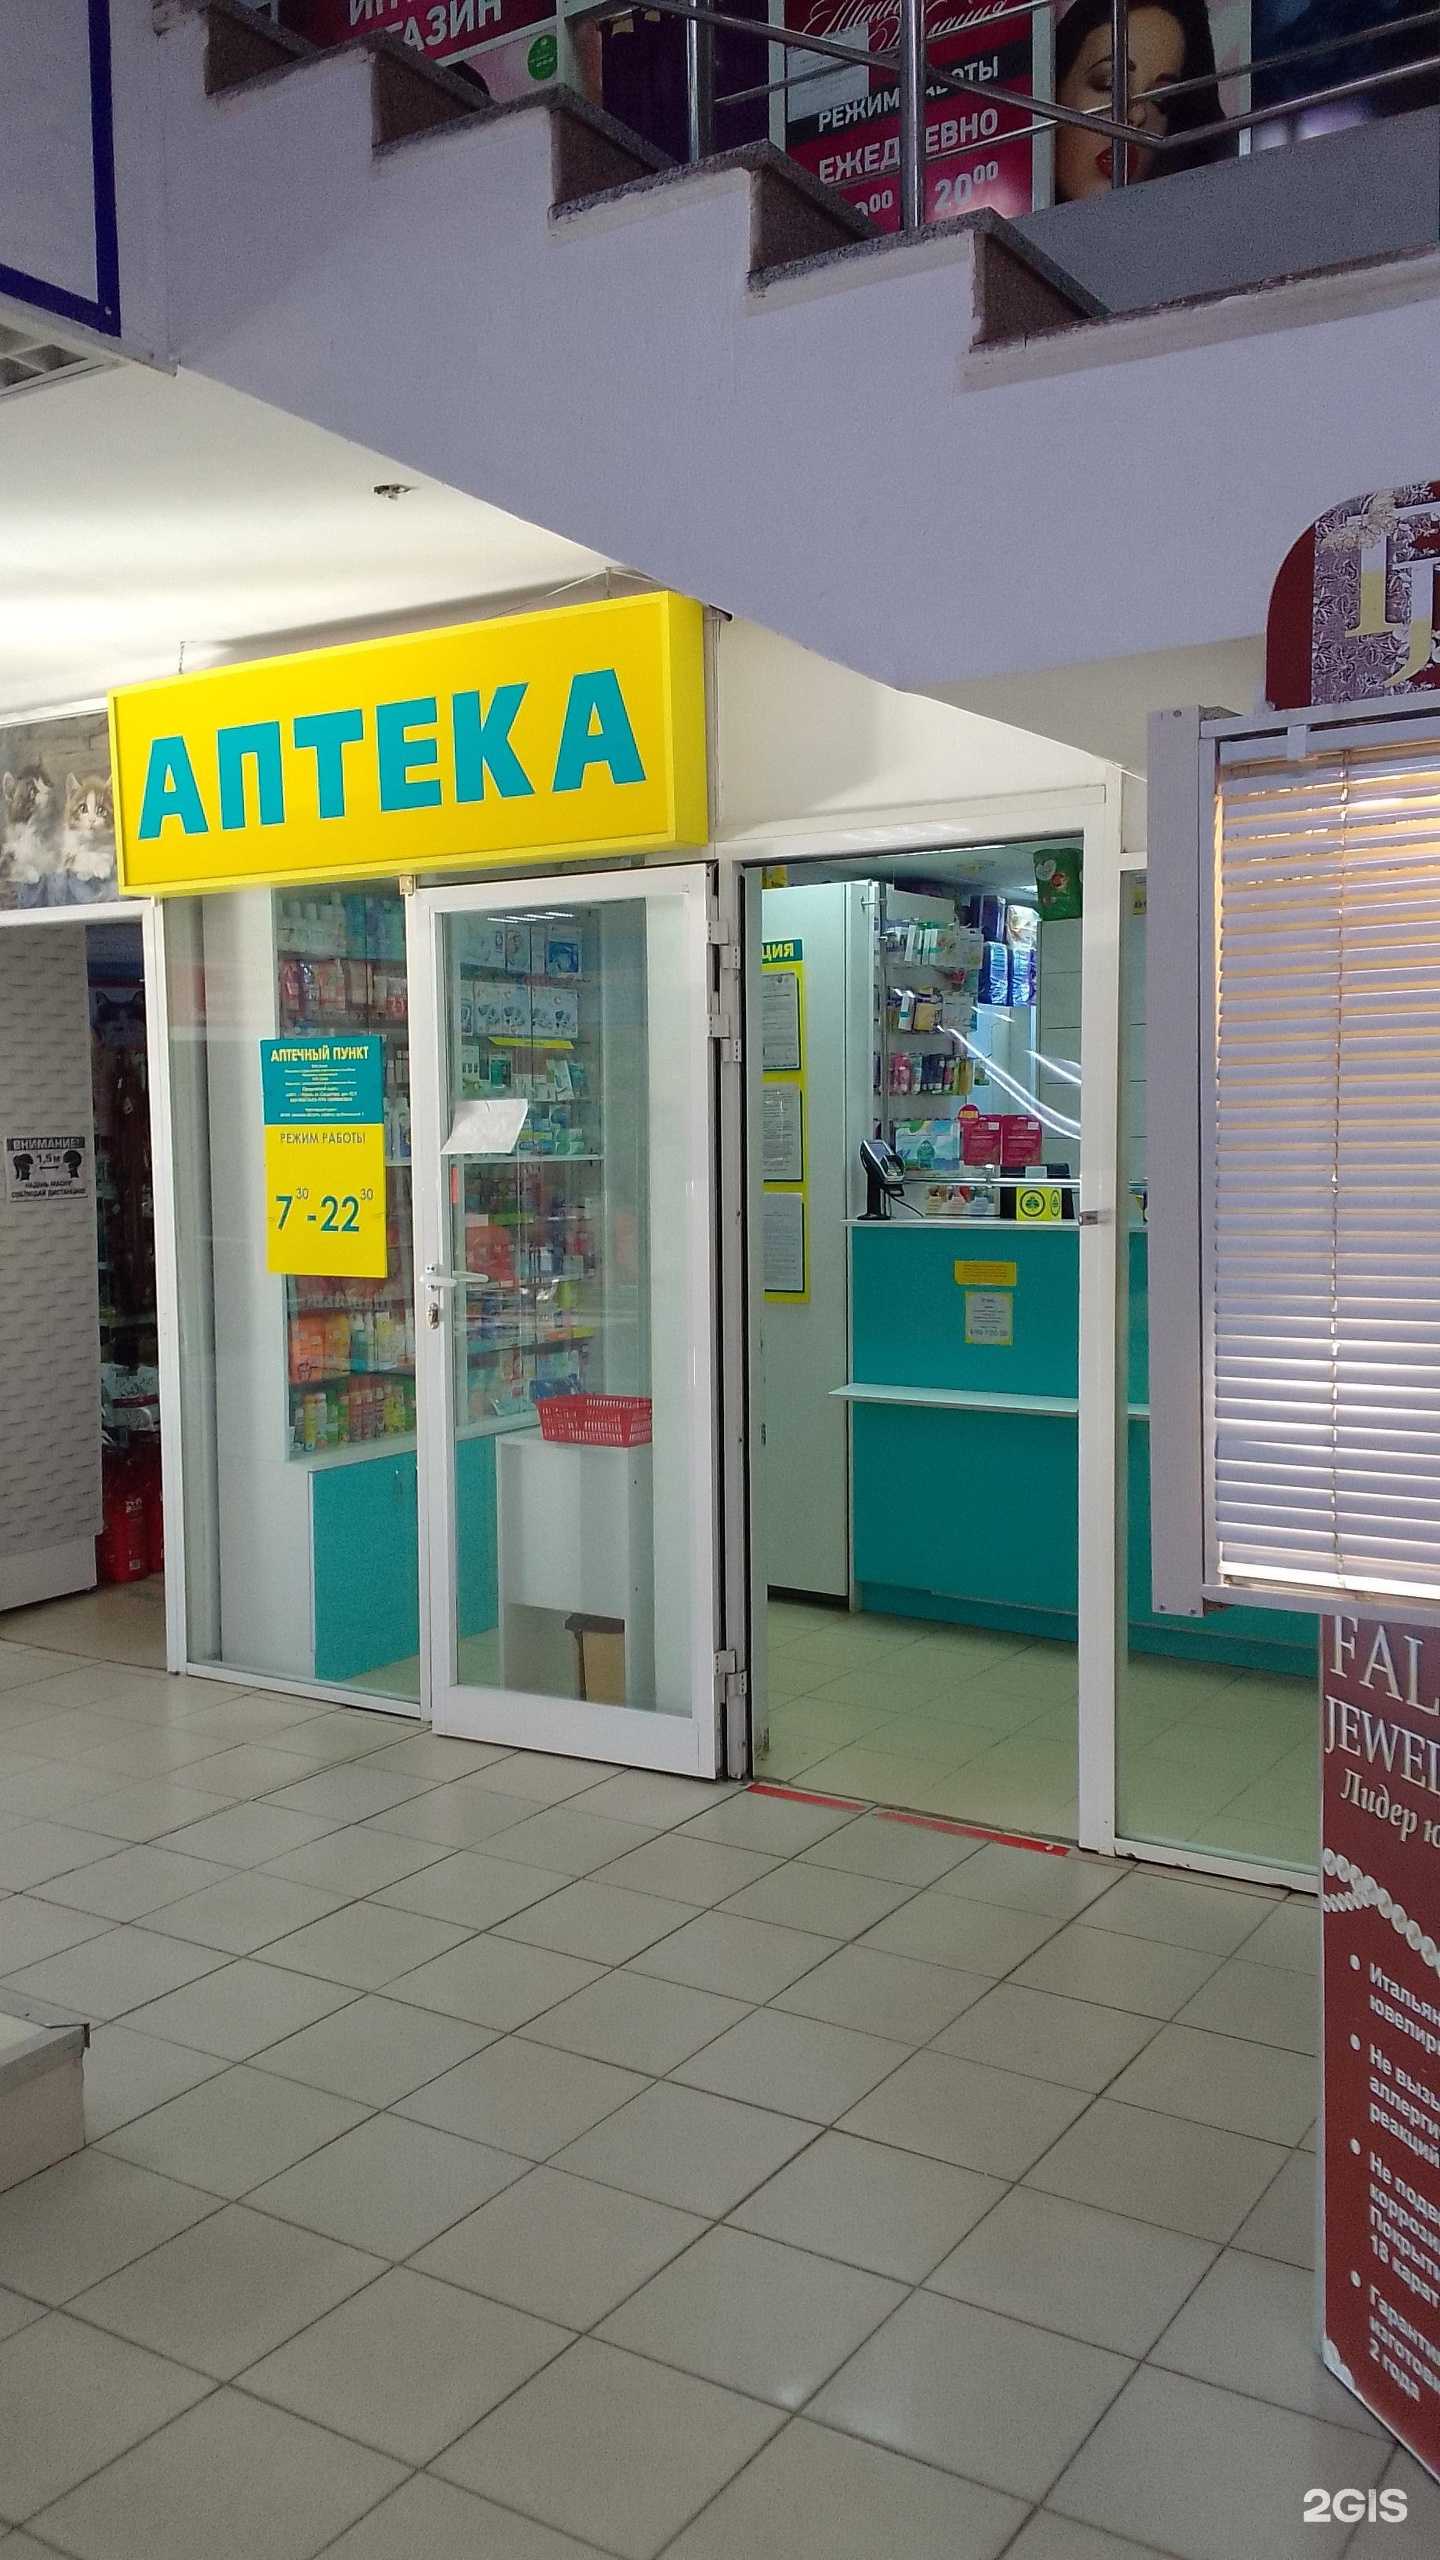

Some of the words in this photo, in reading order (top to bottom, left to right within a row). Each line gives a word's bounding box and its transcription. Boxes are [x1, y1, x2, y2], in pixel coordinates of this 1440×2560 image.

[387, 0, 502, 51] АЗИН
[818, 87, 901, 132] РЕЖИМ
[819, 107, 999, 184] ЕЖЕДЕВНО
[137, 668, 647, 842] АПТЕКА
[762, 942, 794, 961] ЦИЯ
[270, 1045, 330, 1063] АПТЕЧНЫЙ
[333, 1045, 369, 1061] ПУНКТ
[280, 1132, 319, 1145] РЕЖИМ
[322, 1132, 366, 1144] РАБОТЫ
[1340, 1768, 1417, 1842] Лидер
[1369, 1994, 1440, 2056] ювелир
[1369, 2043, 1393, 2076] Не
[1369, 2151, 1393, 2185] Не
[1369, 2337, 1380, 2362] 2
